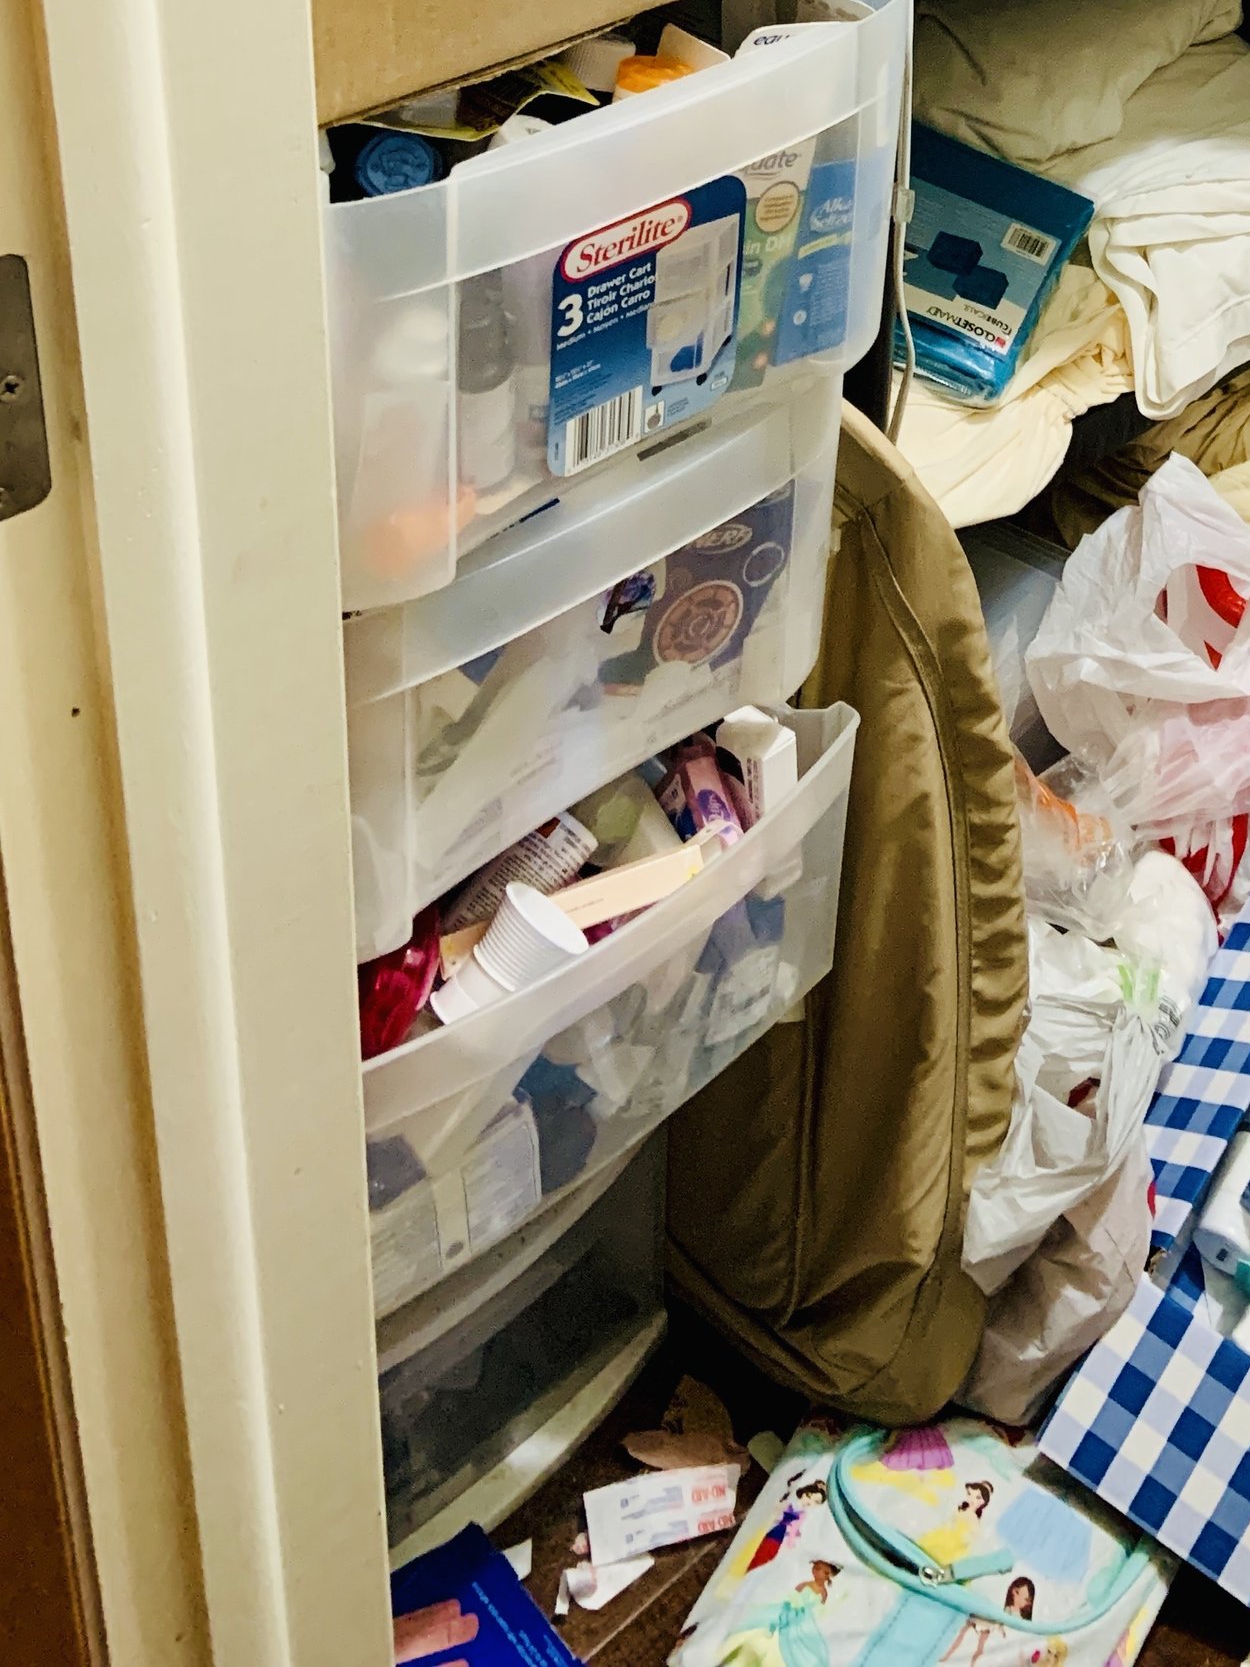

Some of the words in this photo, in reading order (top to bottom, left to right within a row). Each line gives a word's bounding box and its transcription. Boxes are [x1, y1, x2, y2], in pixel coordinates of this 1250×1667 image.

[576, 214, 676, 274] Sterilite
[587, 275, 627, 299] Drawer
[629, 262, 653, 280] Cart
[557, 294, 584, 338] 3
[586, 306, 618, 325] Cajón
[621, 290, 651, 309] Carro
[587, 292, 617, 311] Tiroir
